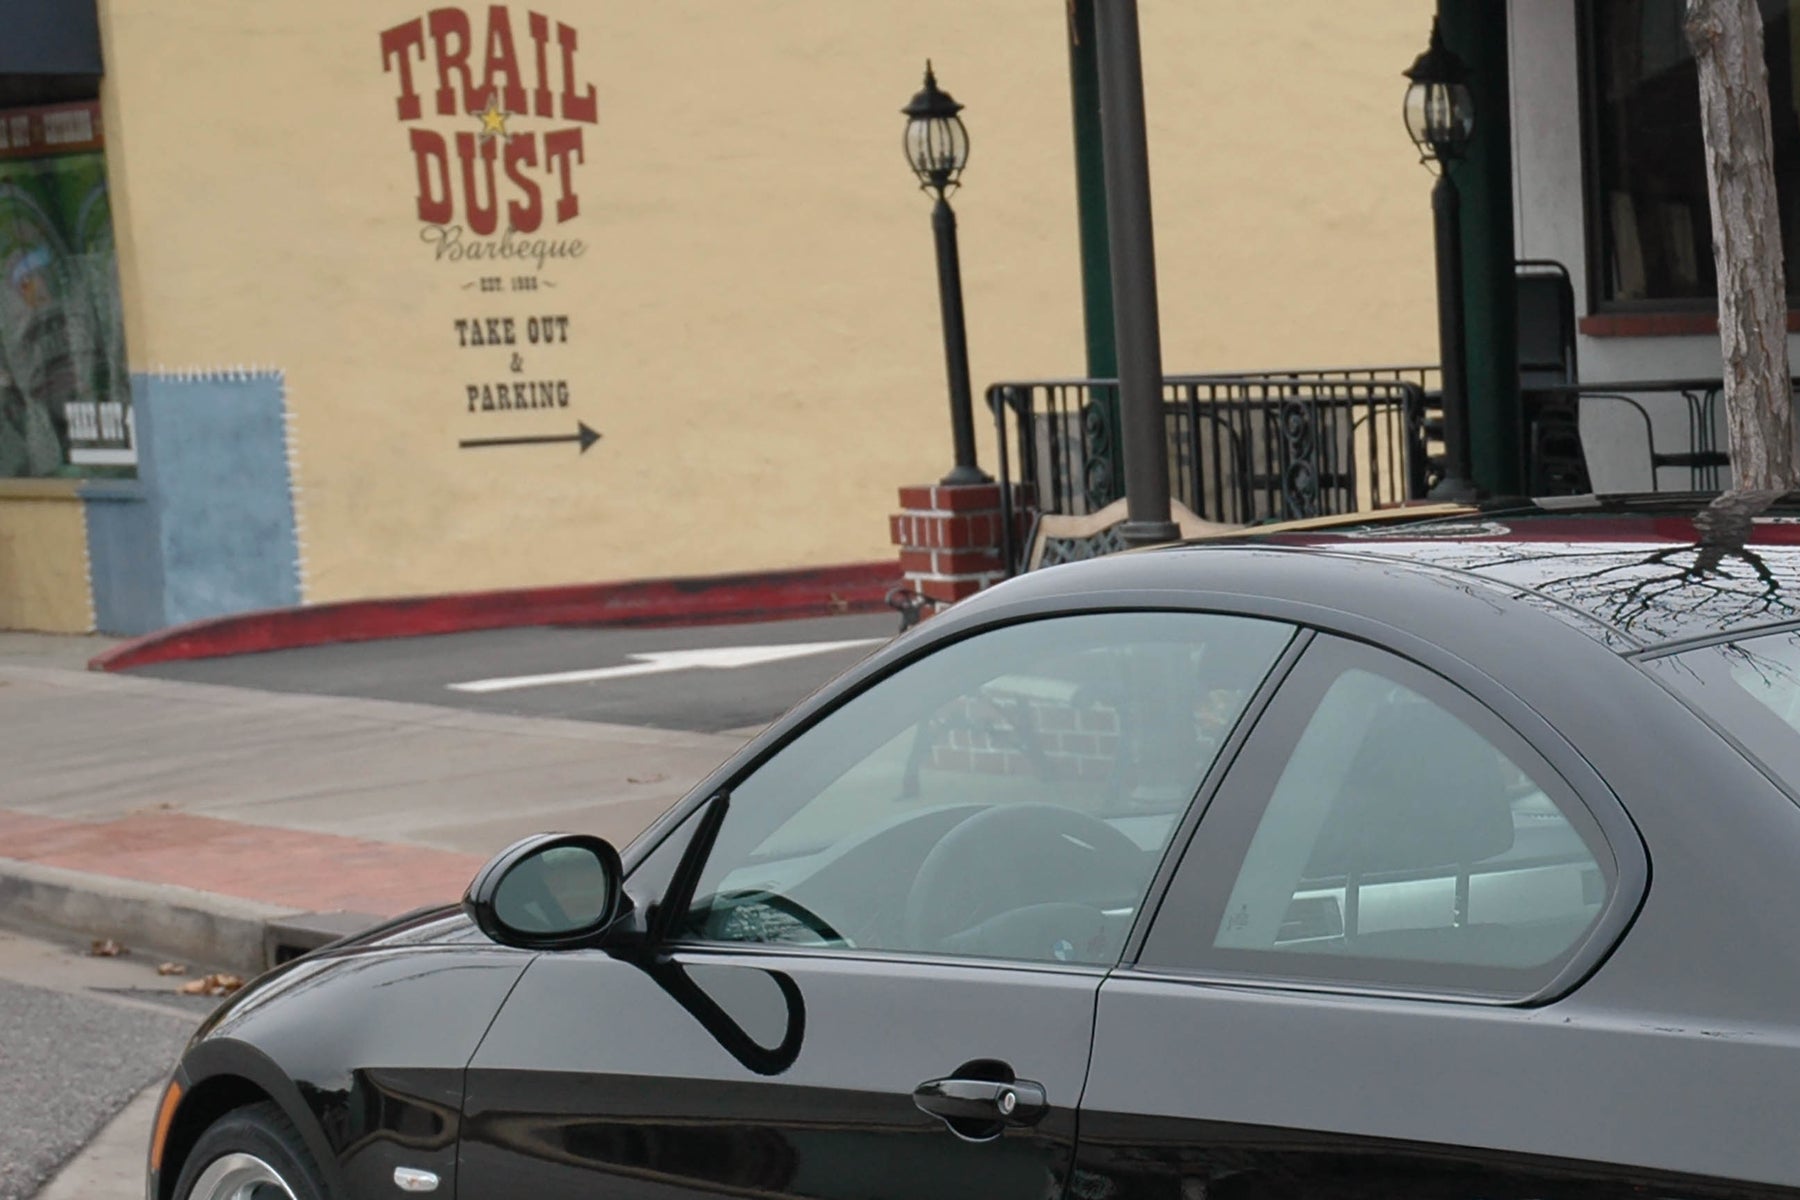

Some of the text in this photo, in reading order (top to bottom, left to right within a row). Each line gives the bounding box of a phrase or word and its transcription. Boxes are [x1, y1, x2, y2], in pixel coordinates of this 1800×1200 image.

[379, 4, 598, 124] TRAIL
[409, 127, 584, 236] DUST
[420, 225, 586, 271] Barbeque
[455, 314, 569, 347] TAKE OUT
[510, 351, 524, 373] &
[466, 380, 569, 413] PARKING
